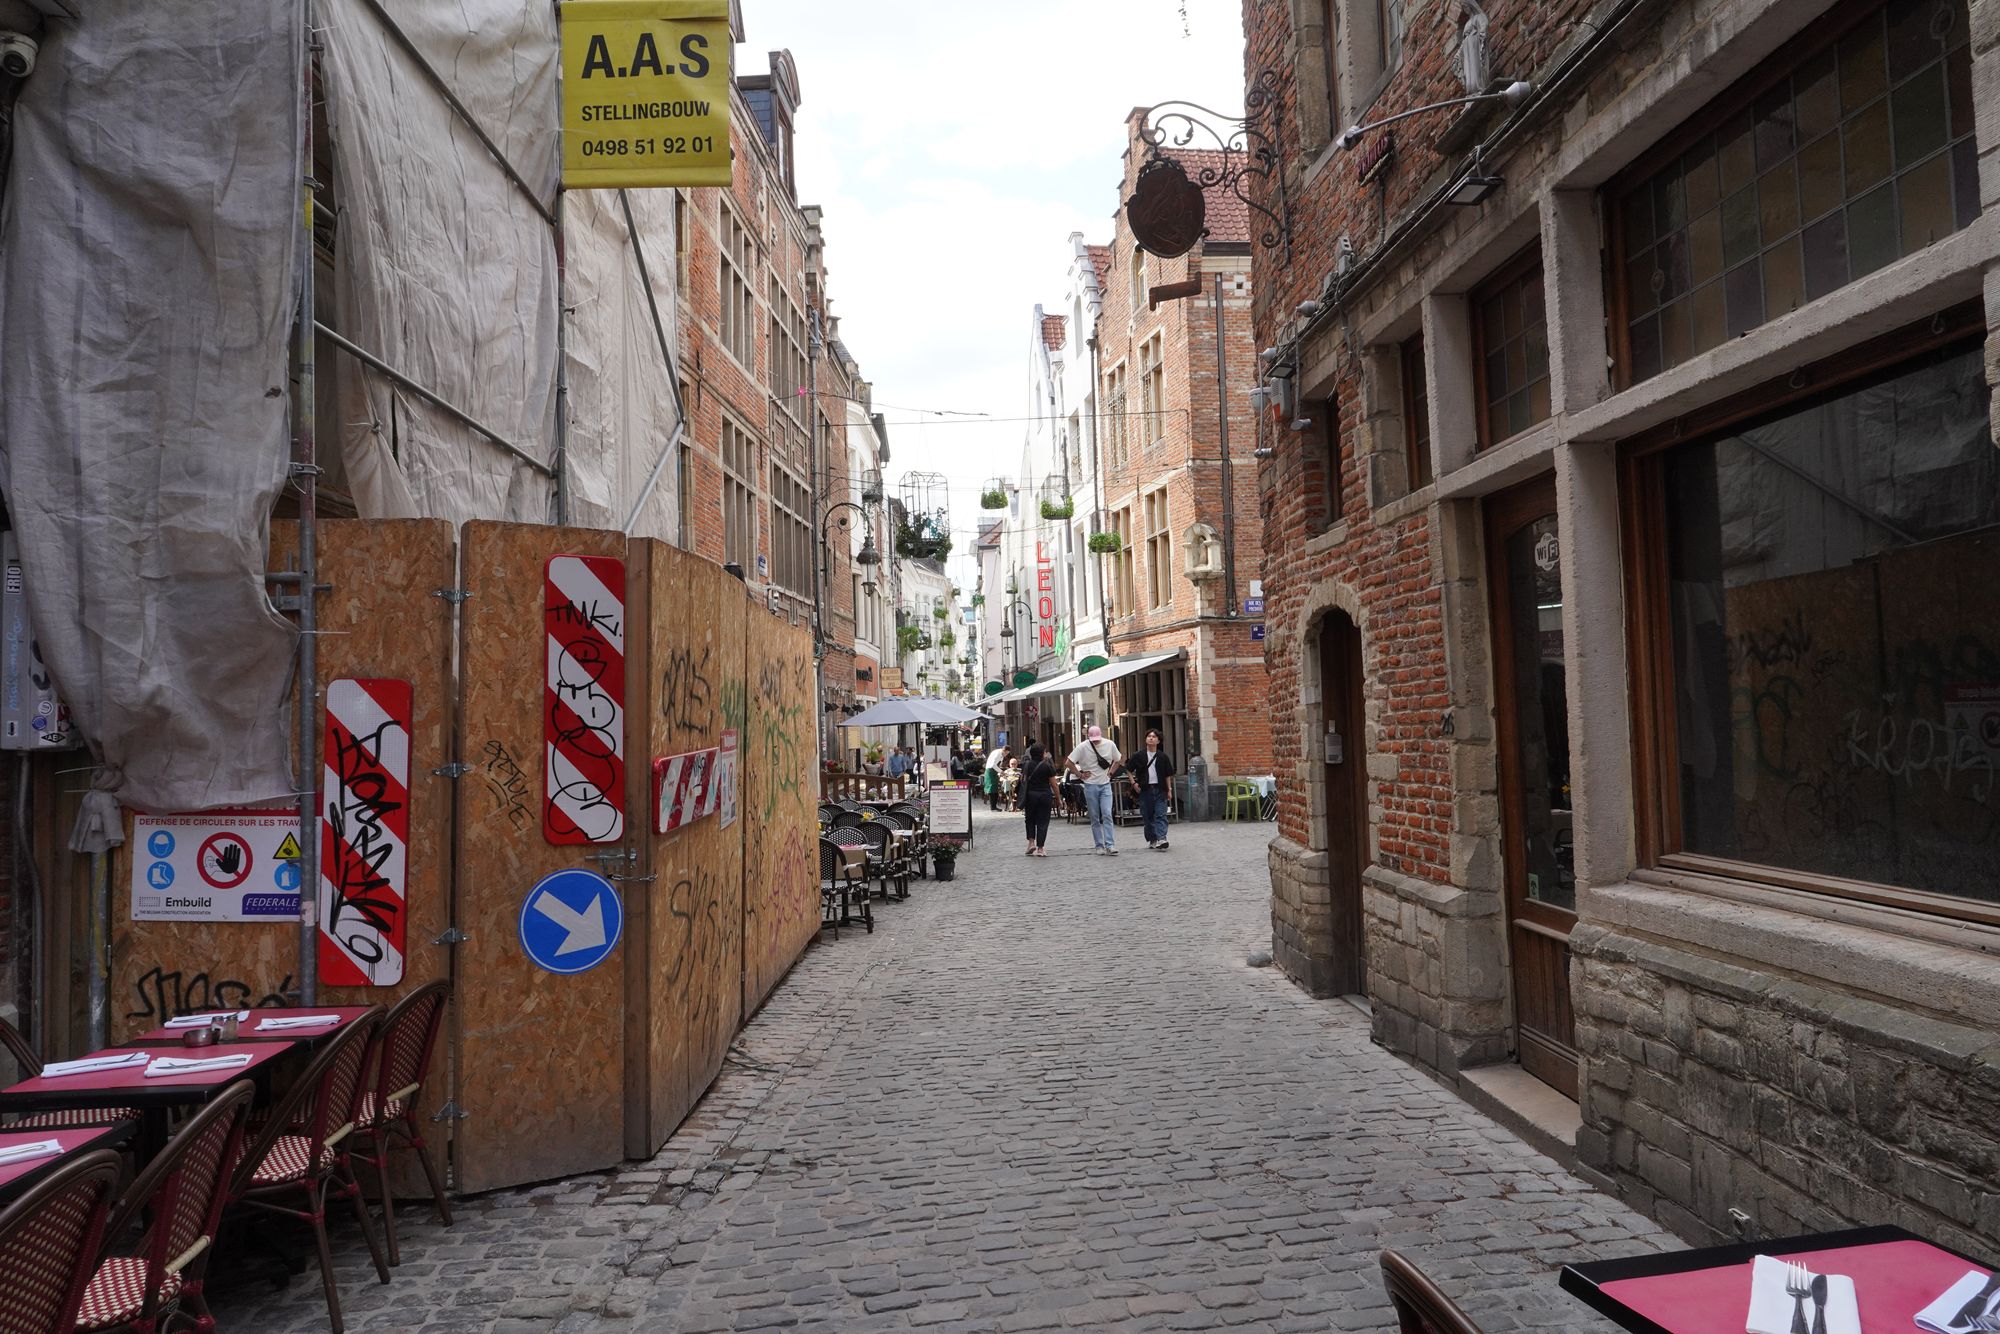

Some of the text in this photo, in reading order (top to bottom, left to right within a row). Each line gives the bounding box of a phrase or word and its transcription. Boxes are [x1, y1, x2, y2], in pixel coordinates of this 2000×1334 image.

[581, 33, 710, 79] A.A.S
[581, 101, 710, 121] STELLINGBOUW
[582, 136, 713, 156] 0498 51 92 01
[6, 566, 21, 593] FRIO
[1036, 541, 1054, 648] LEON
[139, 818, 178, 826] DEFENSE
[238, 819, 256, 827] SUR
[258, 819, 275, 827] LES
[277, 819, 301, 827] TRAV
[165, 897, 212, 908] Embuild
[246, 897, 299, 907] FEDERALE
